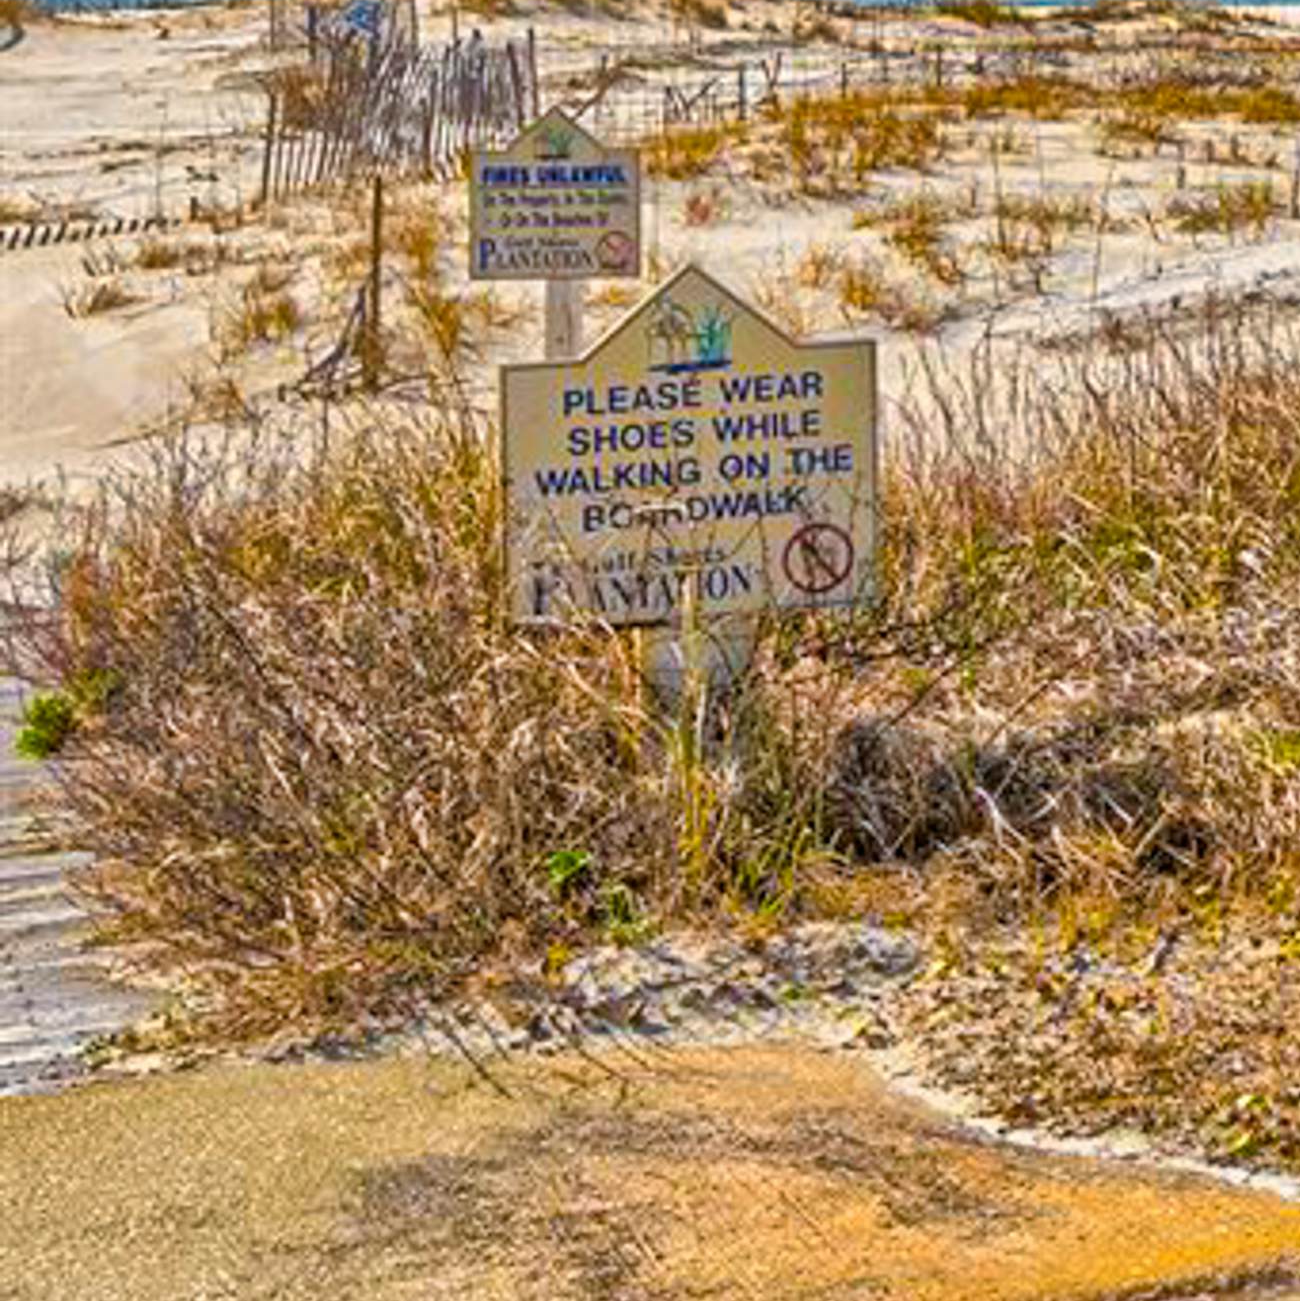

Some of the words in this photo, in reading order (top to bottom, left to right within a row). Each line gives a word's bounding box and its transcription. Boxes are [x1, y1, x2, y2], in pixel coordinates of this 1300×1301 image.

[478, 237, 596, 271] PLANTATION
[563, 381, 703, 417] PLEASE
[720, 371, 824, 405] WEAR
[567, 419, 695, 457] SHOES
[713, 409, 822, 442] WHILE
[535, 456, 702, 498] WALKING
[719, 453, 770, 481] ON
[790, 443, 853, 475] THE
